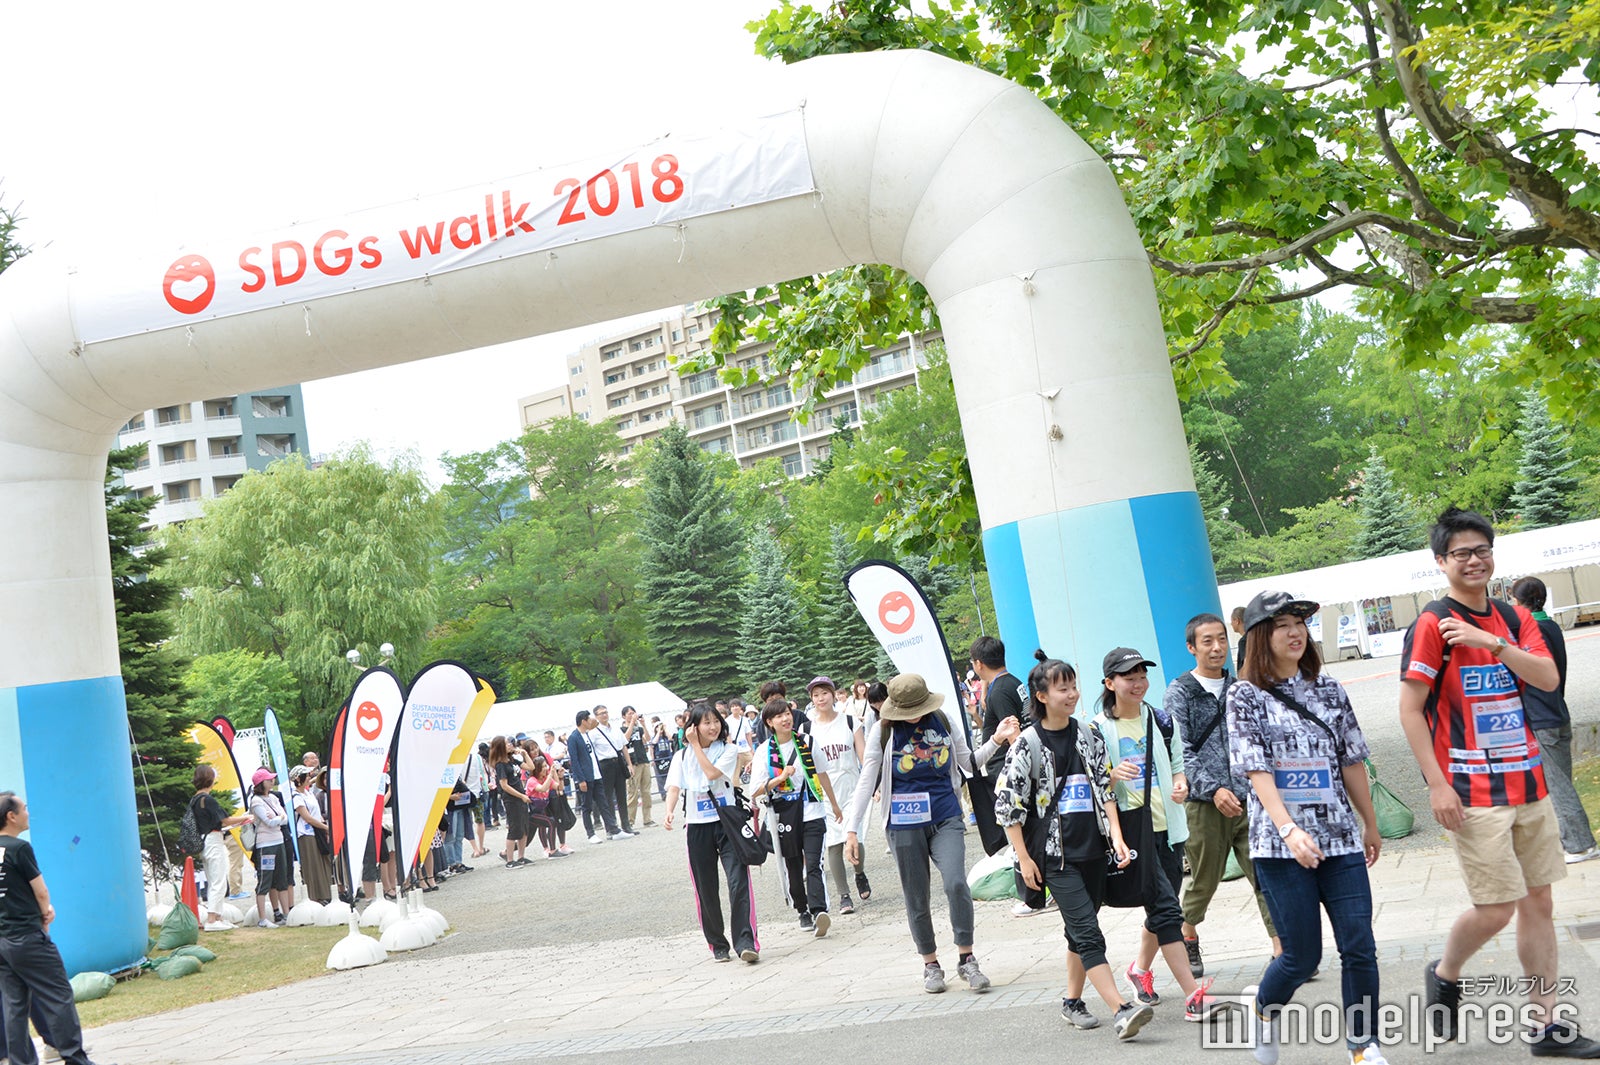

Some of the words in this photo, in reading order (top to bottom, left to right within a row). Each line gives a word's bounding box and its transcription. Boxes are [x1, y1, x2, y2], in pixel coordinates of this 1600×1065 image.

[239, 229, 383, 293] SDGs
[398, 190, 536, 260] walk
[553, 154, 684, 226] 2018
[412, 704, 456, 712] SUSTAINABLE
[412, 711, 456, 719] DEVELOPMENT
[412, 718, 456, 731] GOALS
[1490, 713, 1521, 731] 223
[1286, 772, 1321, 788] 224
[1061, 786, 1086, 801] 215
[898, 802, 922, 813] 242
